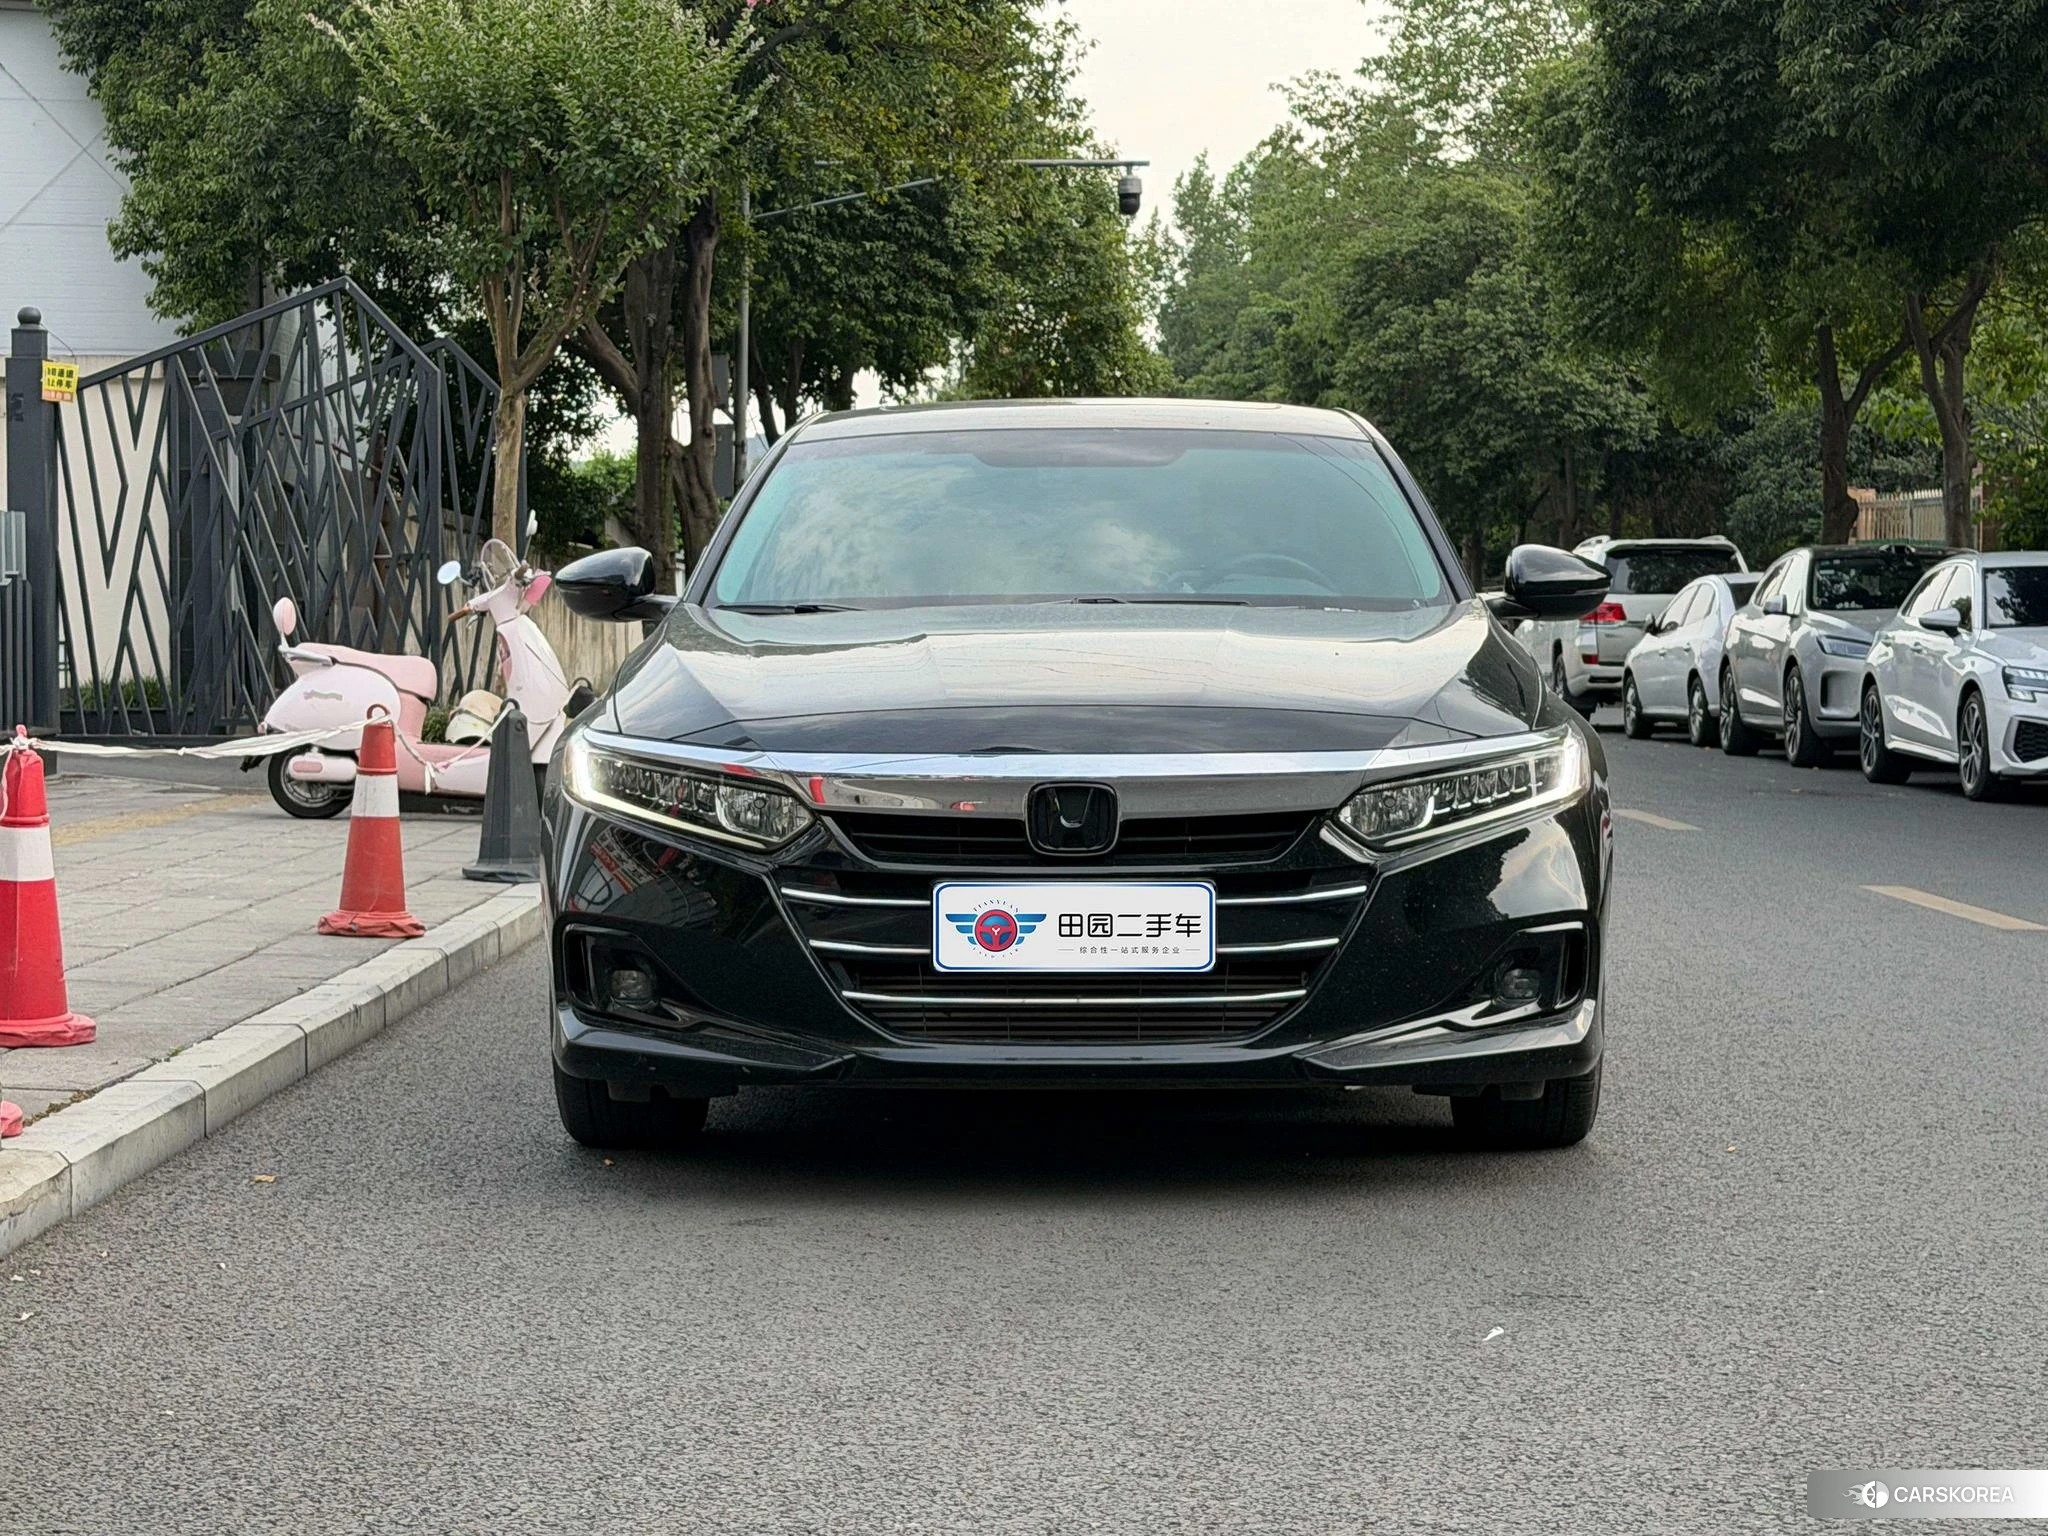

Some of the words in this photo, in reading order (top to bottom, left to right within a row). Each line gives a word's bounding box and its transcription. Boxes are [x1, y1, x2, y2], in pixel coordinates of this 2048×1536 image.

[1059, 913, 1202, 938] 田园二手车
[1079, 946, 1180, 955] 综合性一站式服务企业
